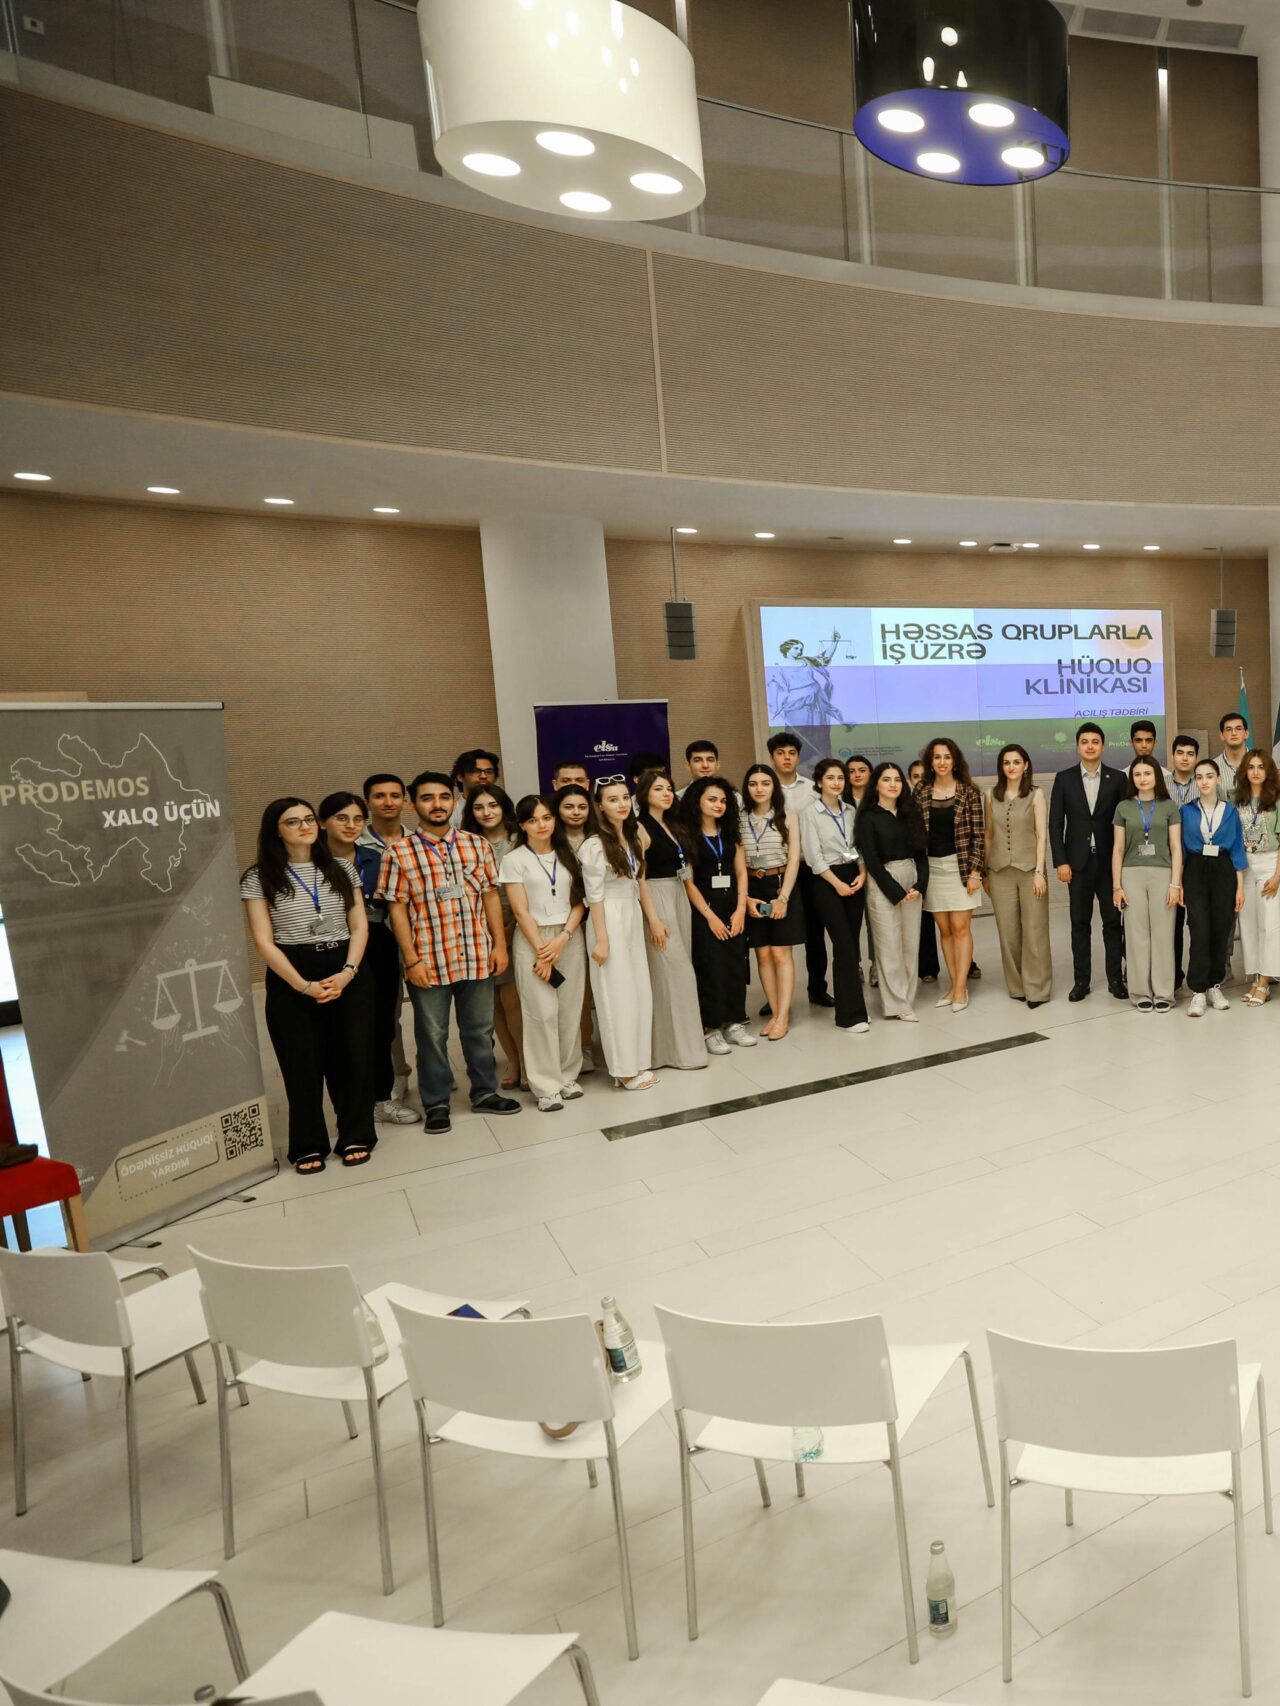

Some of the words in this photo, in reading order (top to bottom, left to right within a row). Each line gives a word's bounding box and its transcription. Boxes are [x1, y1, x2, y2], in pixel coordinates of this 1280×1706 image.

[880, 623, 993, 641] HƏSSAS
[1001, 623, 1153, 641] QRUPLARLA
[881, 641, 906, 664] İŞ
[911, 641, 987, 660] ÜZRƏ
[1057, 655, 1152, 675] HÜQUQ
[1025, 674, 1148, 695] KLİNİKASI
[1075, 709, 1108, 719] AÇILIŞ
[1110, 707, 1149, 716] TƏDBİRİ
[593, 740, 618, 752] elsa
[0, 776, 149, 806] PRODEMOS
[102, 806, 160, 828] XALQ
[164, 799, 220, 825] ÜÇÜN
[151, 1157, 190, 1179] YARDIM
